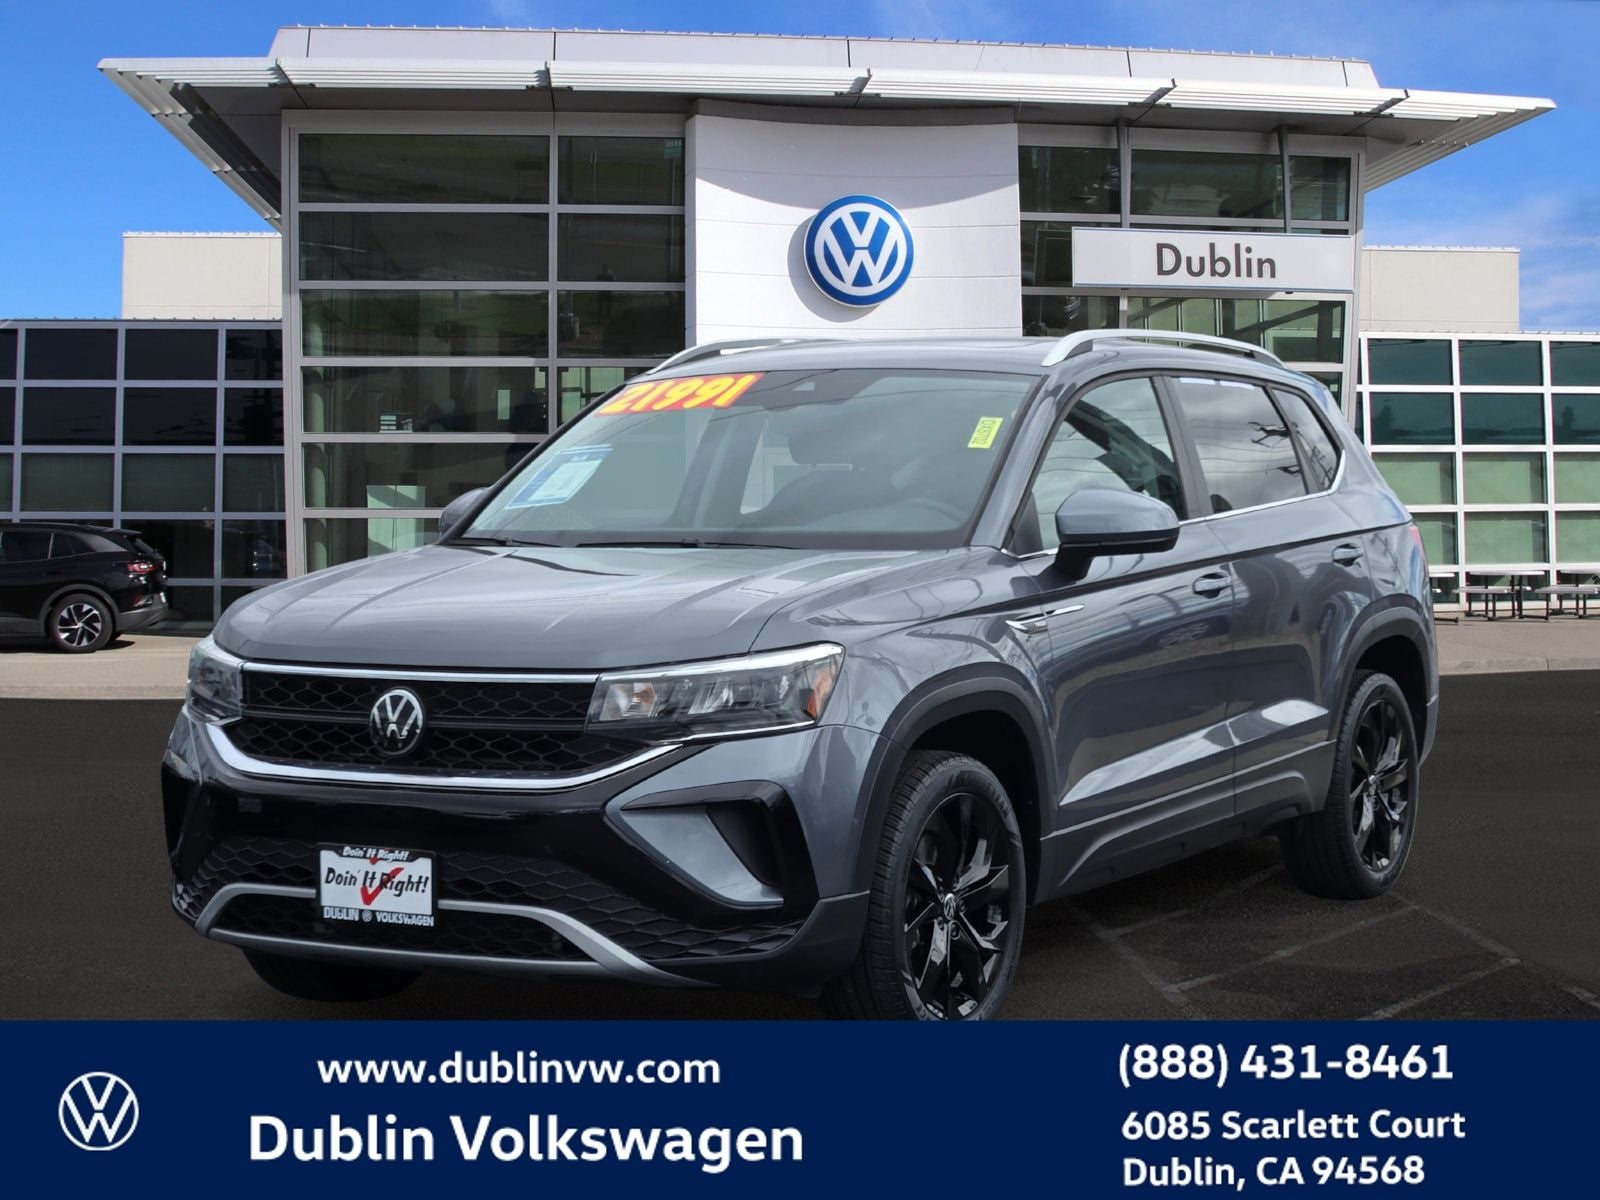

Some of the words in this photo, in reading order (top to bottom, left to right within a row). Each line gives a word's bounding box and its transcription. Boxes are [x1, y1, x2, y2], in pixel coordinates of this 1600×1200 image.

[814, 203, 907, 296] VW
[1156, 242, 1277, 280] Dublin
[599, 373, 756, 414] 21991
[325, 867, 361, 886] Doin'
[363, 870, 376, 888] It
[380, 872, 429, 897] Right!
[323, 906, 360, 921] DUBLIN
[375, 911, 435, 927] VOLKSWAGEN
